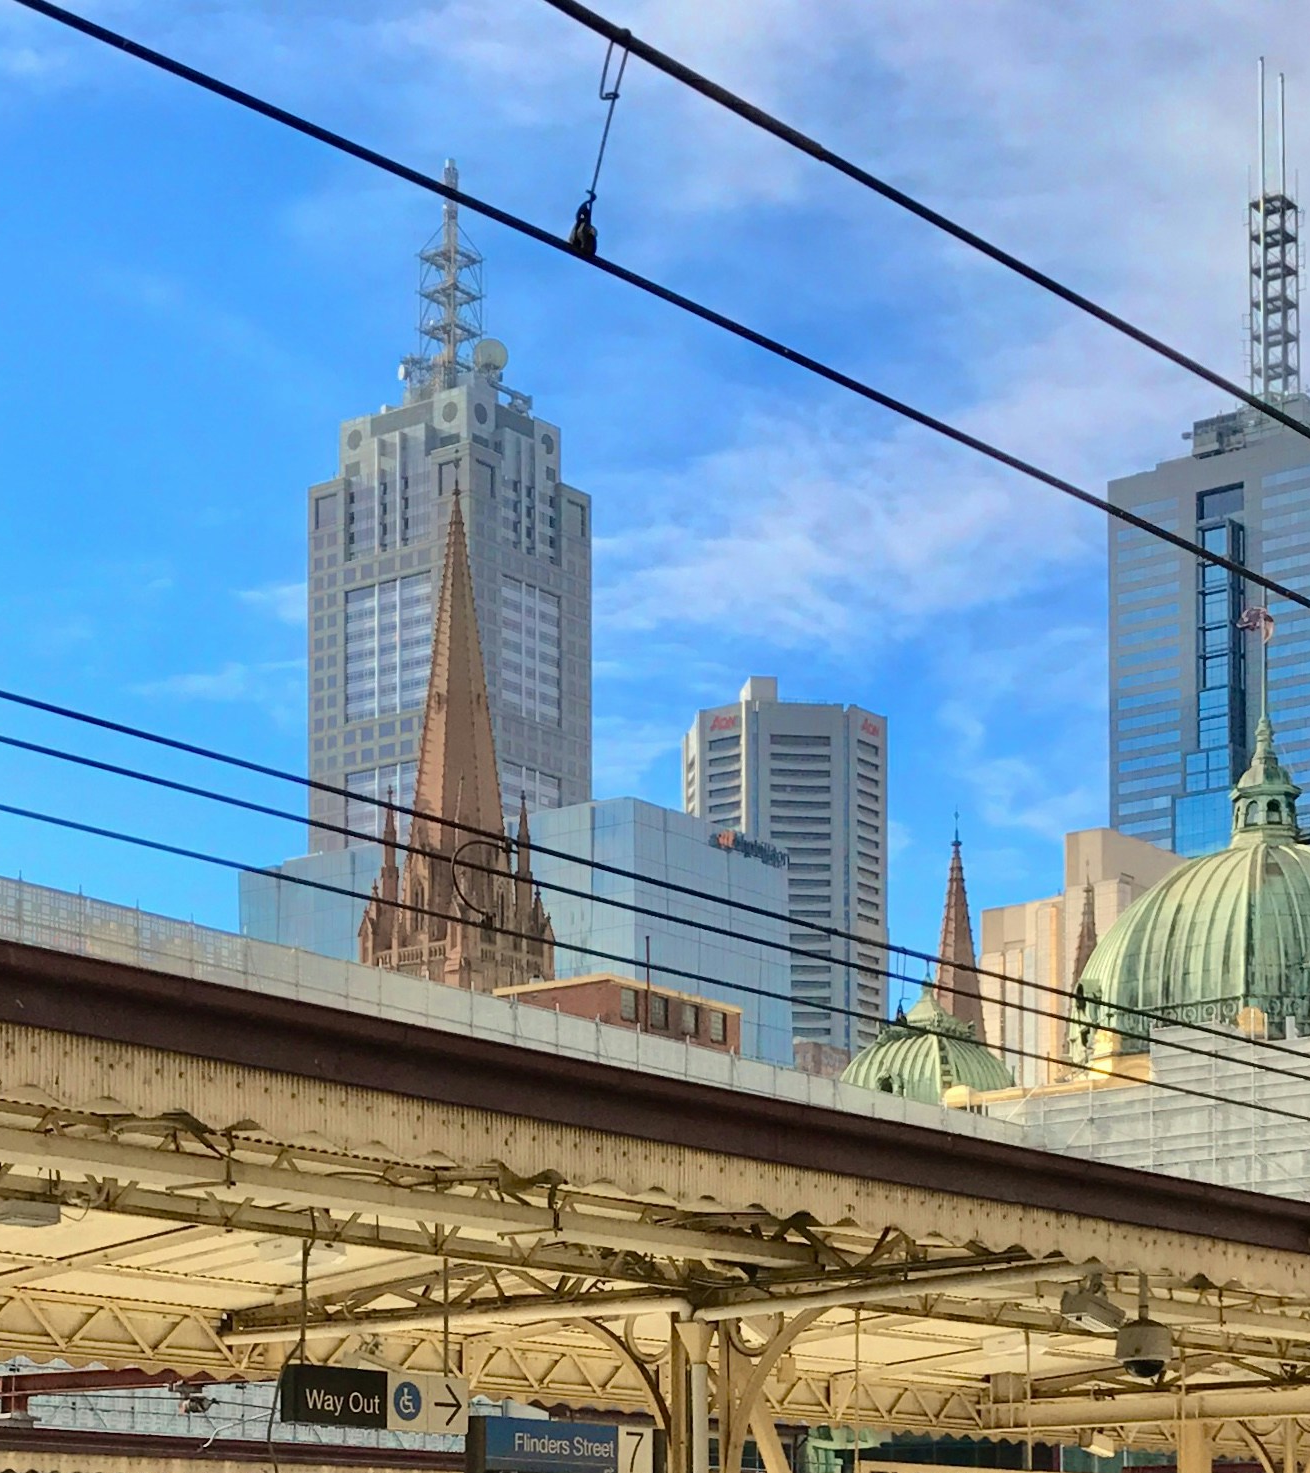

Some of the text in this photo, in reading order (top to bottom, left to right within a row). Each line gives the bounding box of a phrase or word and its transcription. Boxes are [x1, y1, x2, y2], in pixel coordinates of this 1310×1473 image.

[305, 1388, 381, 1416] Way Out
[514, 1432, 570, 1456] Flinders
[573, 1436, 615, 1458] Street
[625, 1431, 645, 1473] 7
